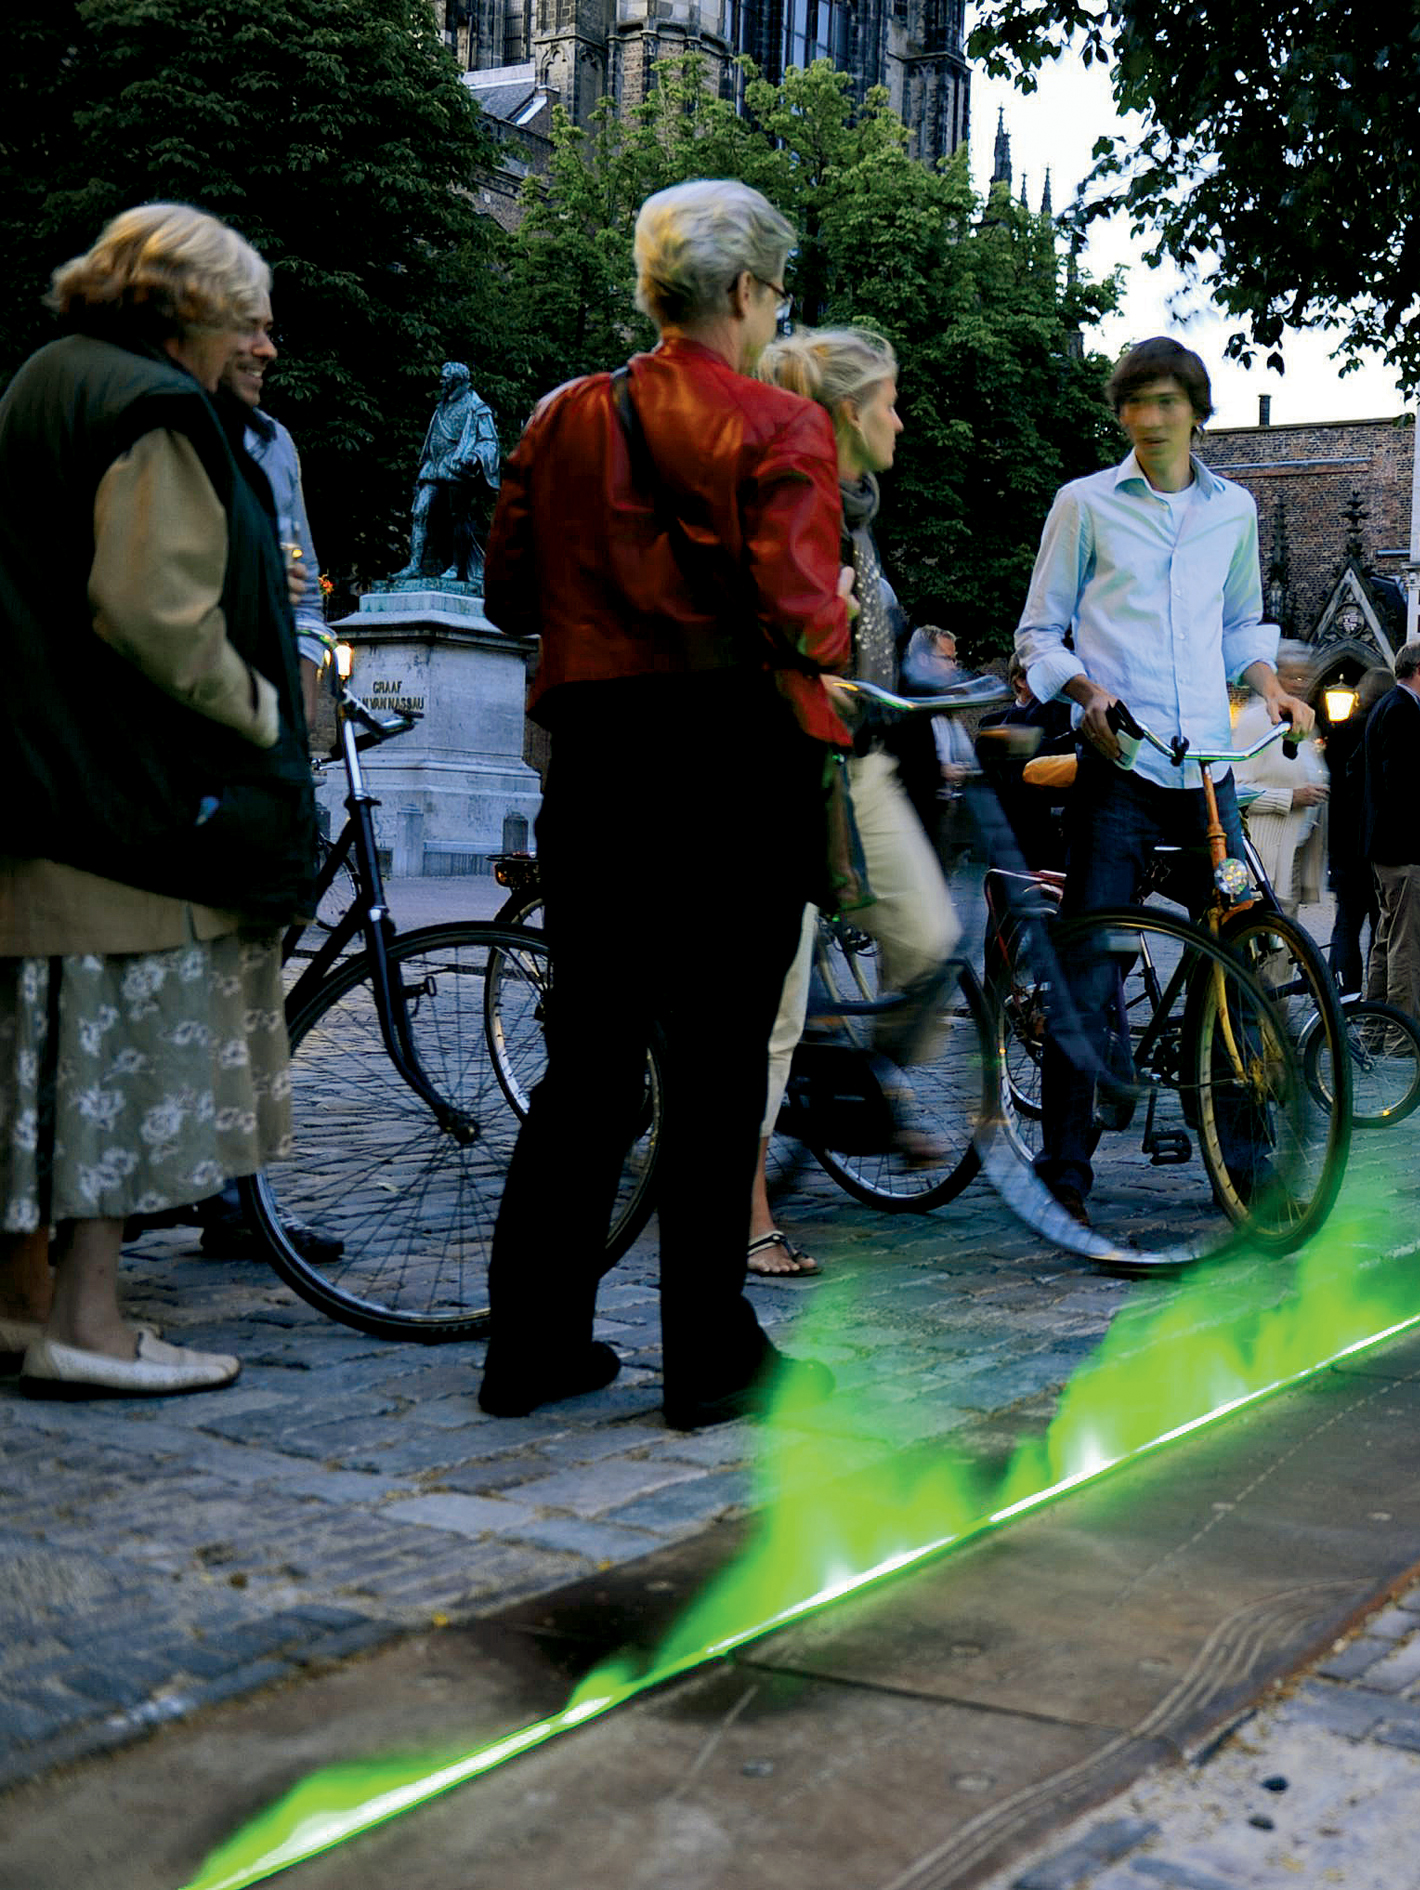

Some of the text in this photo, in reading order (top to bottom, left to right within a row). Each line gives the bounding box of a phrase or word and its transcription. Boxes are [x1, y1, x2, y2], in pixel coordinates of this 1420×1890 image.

[373, 681, 402, 694] GRAAF
[371, 697, 386, 710] VAN
[388, 697, 424, 710] NASSAU
